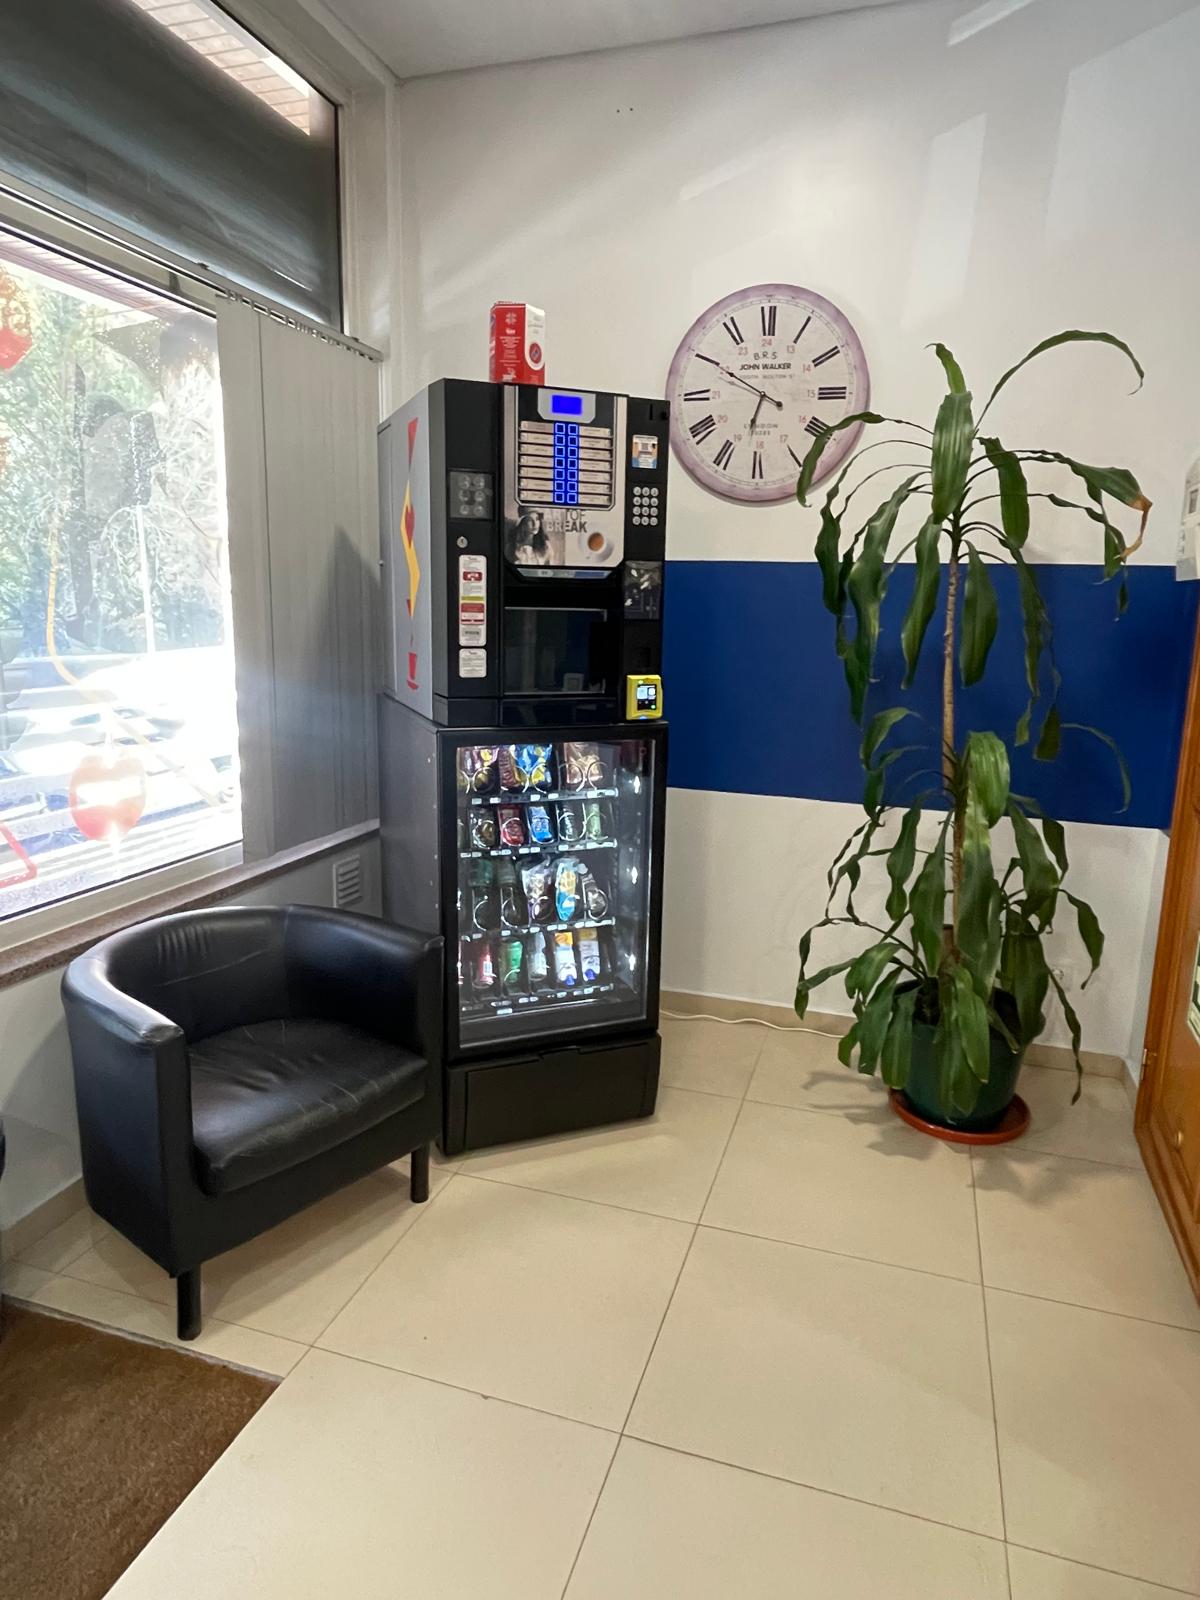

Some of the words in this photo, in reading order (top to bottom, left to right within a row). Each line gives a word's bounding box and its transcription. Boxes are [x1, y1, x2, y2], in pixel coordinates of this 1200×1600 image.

[761, 339, 773, 347] 24
[738, 347, 748, 356] 23
[787, 345, 796, 354] 13
[740, 363, 760, 371] JOHN
[762, 362, 792, 370] WALKER
[803, 364, 811, 373] 14
[711, 391, 720, 399] 21
[807, 389, 815, 398] 15
[718, 415, 728, 423] 20
[799, 415, 807, 423] 16
[733, 434, 742, 442] 19
[780, 434, 788, 442] 17
[545, 521, 588, 533] BREAK
